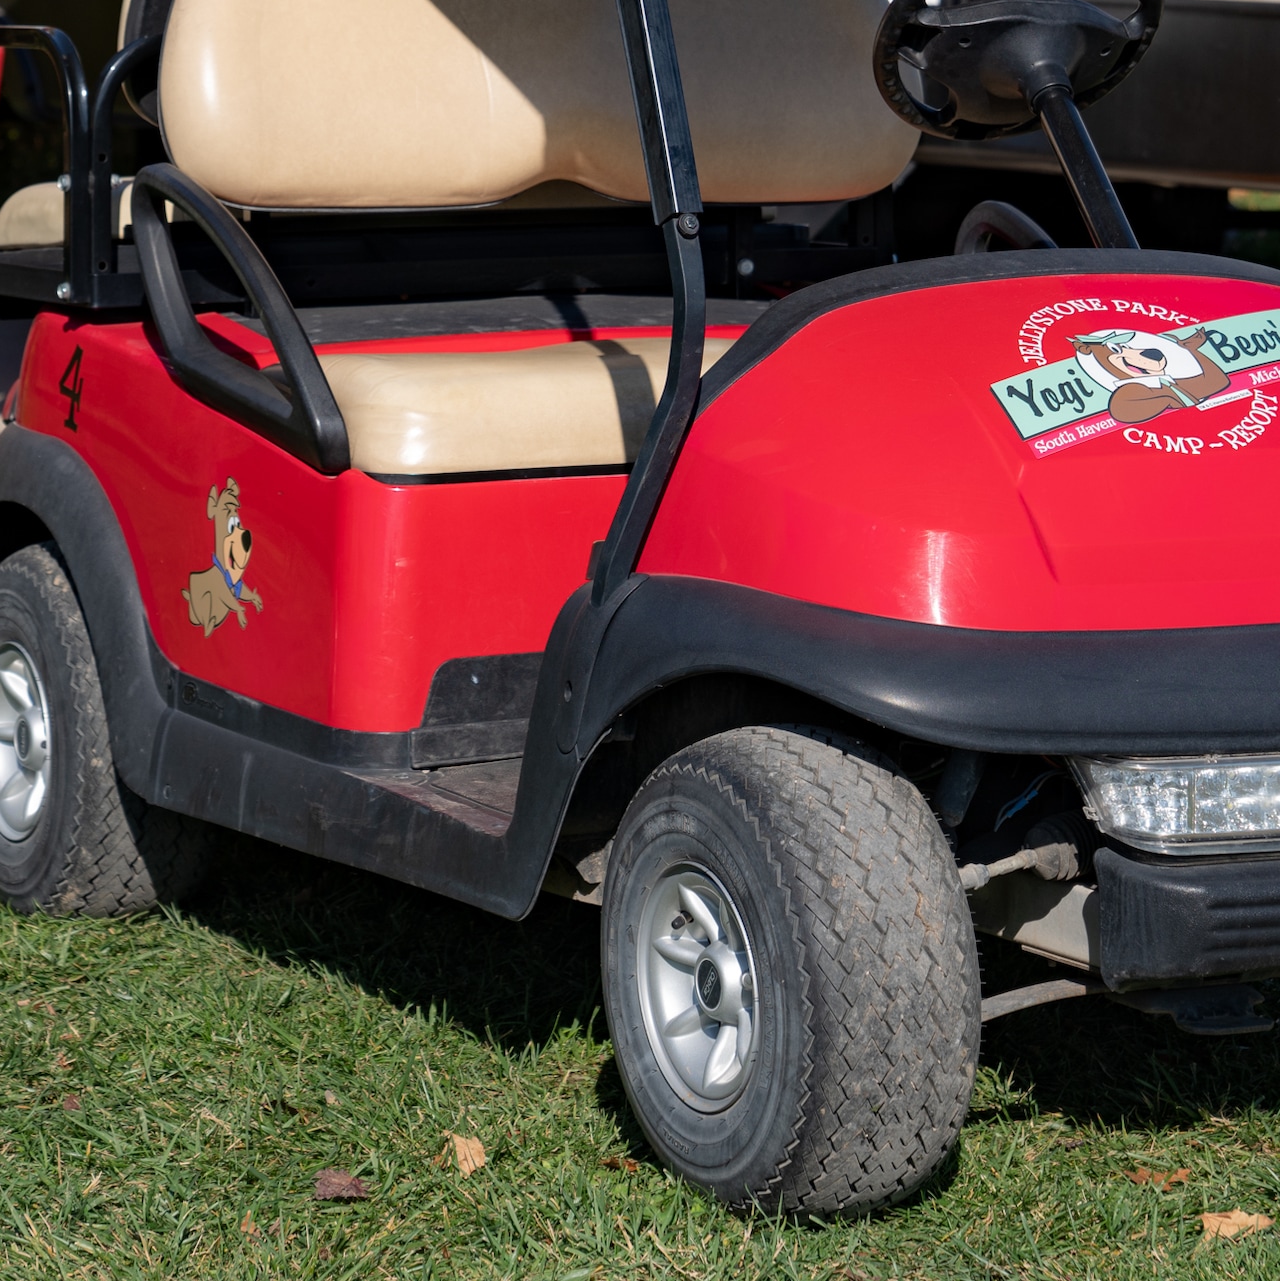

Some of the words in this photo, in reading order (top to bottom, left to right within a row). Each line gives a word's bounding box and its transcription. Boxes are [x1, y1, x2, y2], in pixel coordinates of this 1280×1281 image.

[1019, 298, 1108, 365] JELLYSTONE
[1111, 300, 1188, 326] PARK
[59, 344, 84, 432] 4
[1006, 369, 1094, 417] Yogi
[1034, 429, 1077, 455] South
[1076, 417, 1117, 440] Haven
